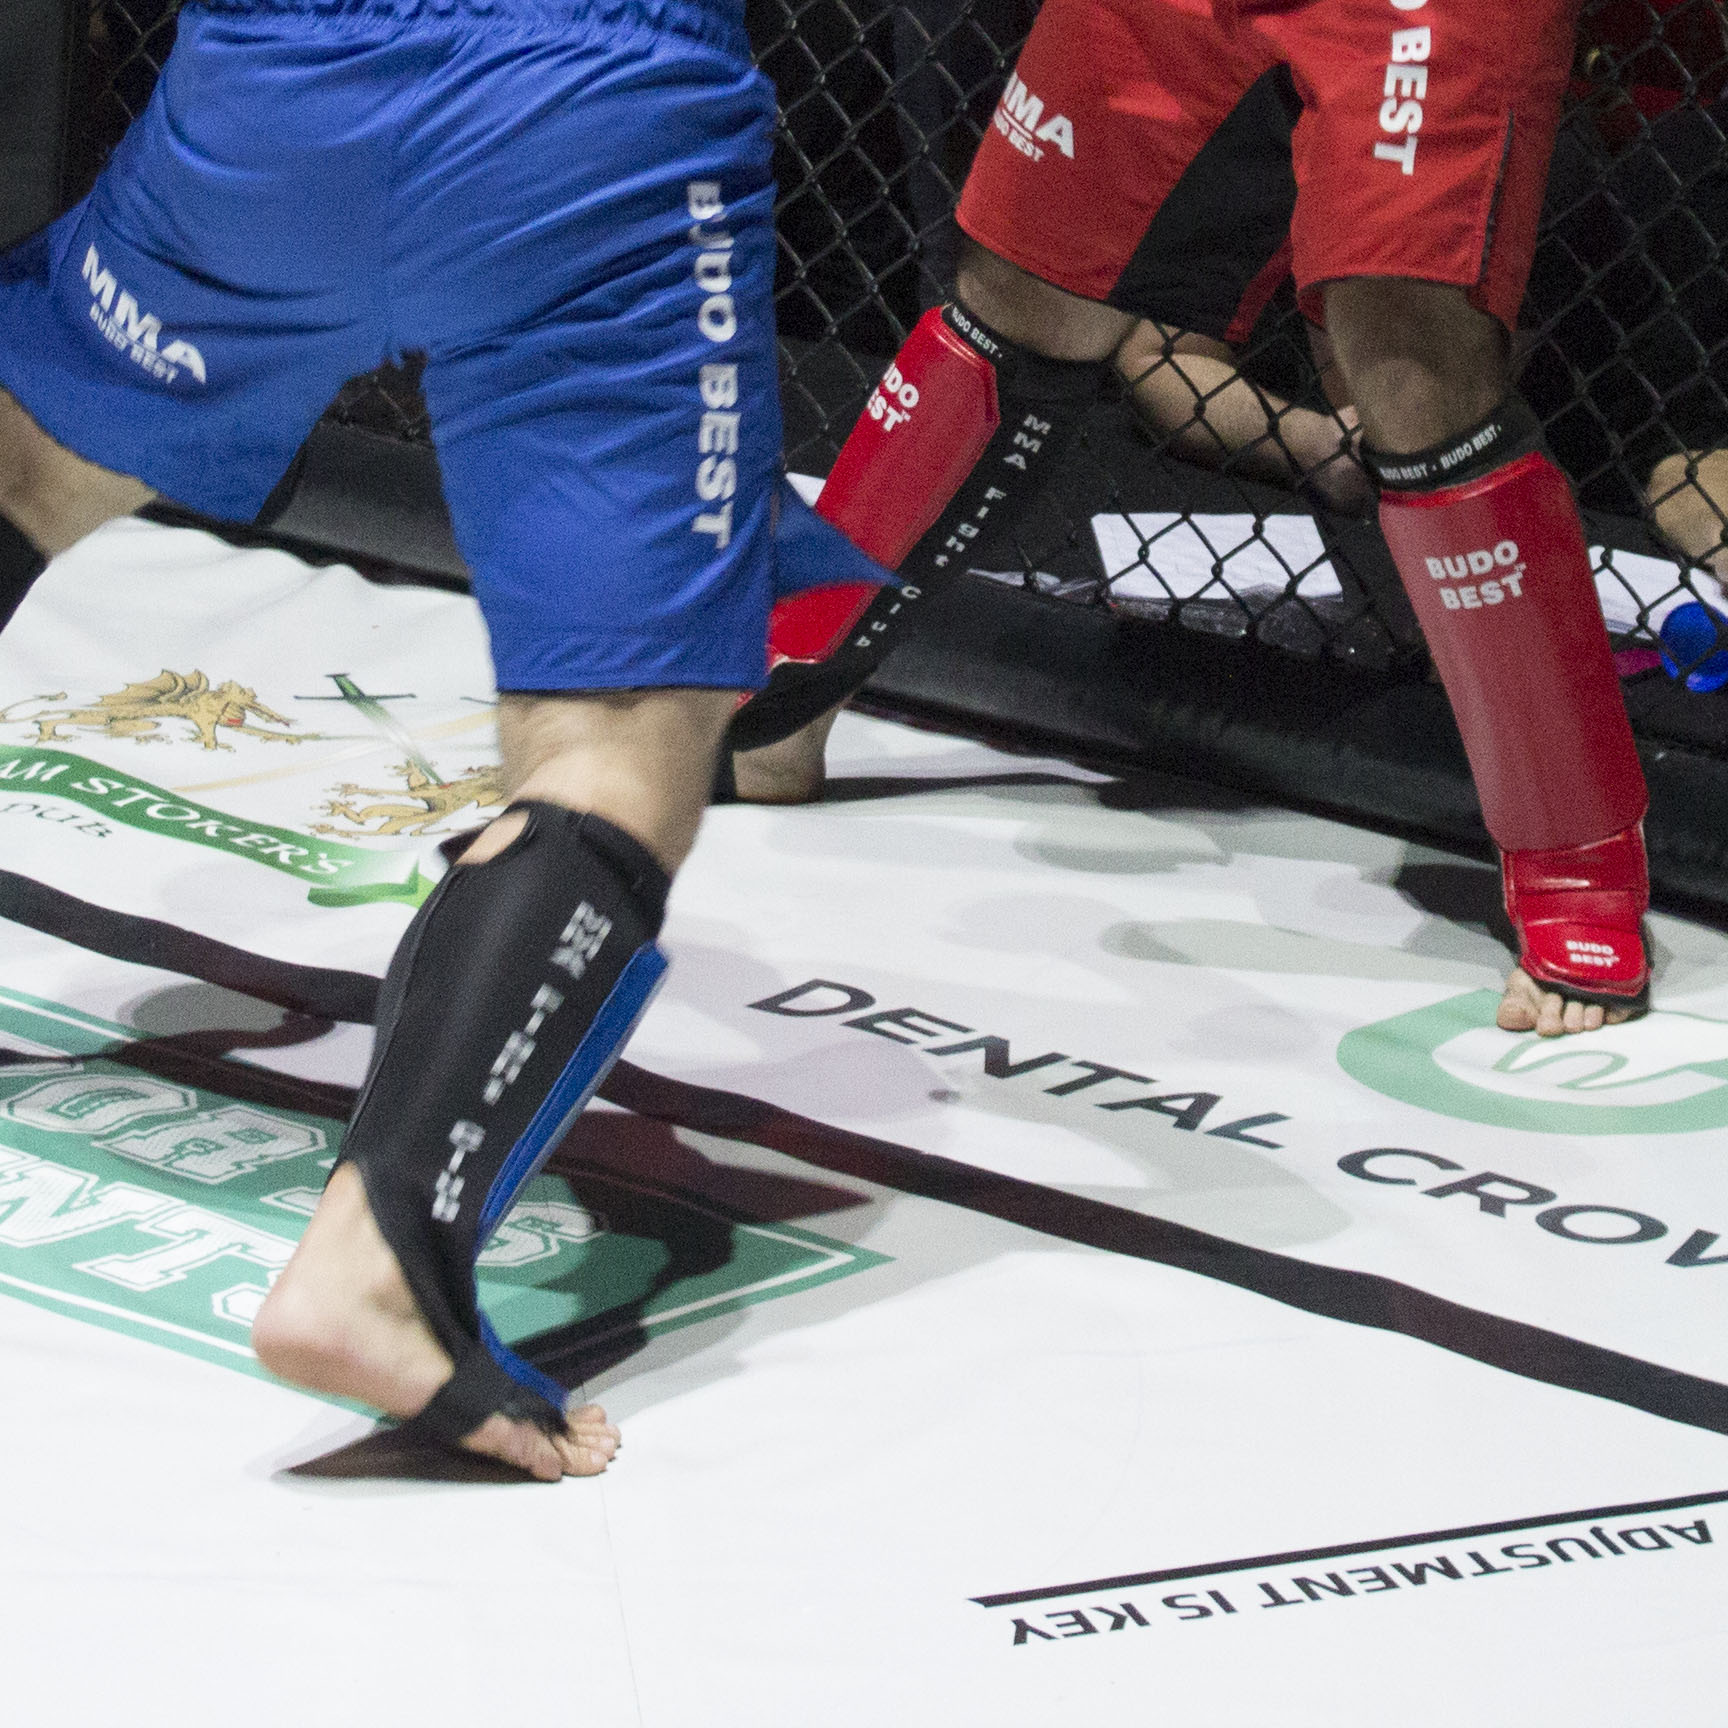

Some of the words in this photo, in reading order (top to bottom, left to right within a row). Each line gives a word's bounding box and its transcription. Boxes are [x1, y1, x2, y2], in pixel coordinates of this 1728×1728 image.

[1371, 25, 1431, 175] BEST
[81, 241, 208, 385] MMA
[692, 362, 741, 550] BEST
[1425, 538, 1520, 580] BUDO
[1439, 569, 1525, 610] BEST
[72, 774, 355, 876] STOKER'S
[746, 977, 1293, 1150] DENTAL
[1176, 1587, 1237, 1621] IS
[1261, 1516, 1715, 1609] ADJUSTMENT
[1007, 1597, 1152, 1647] KEY
